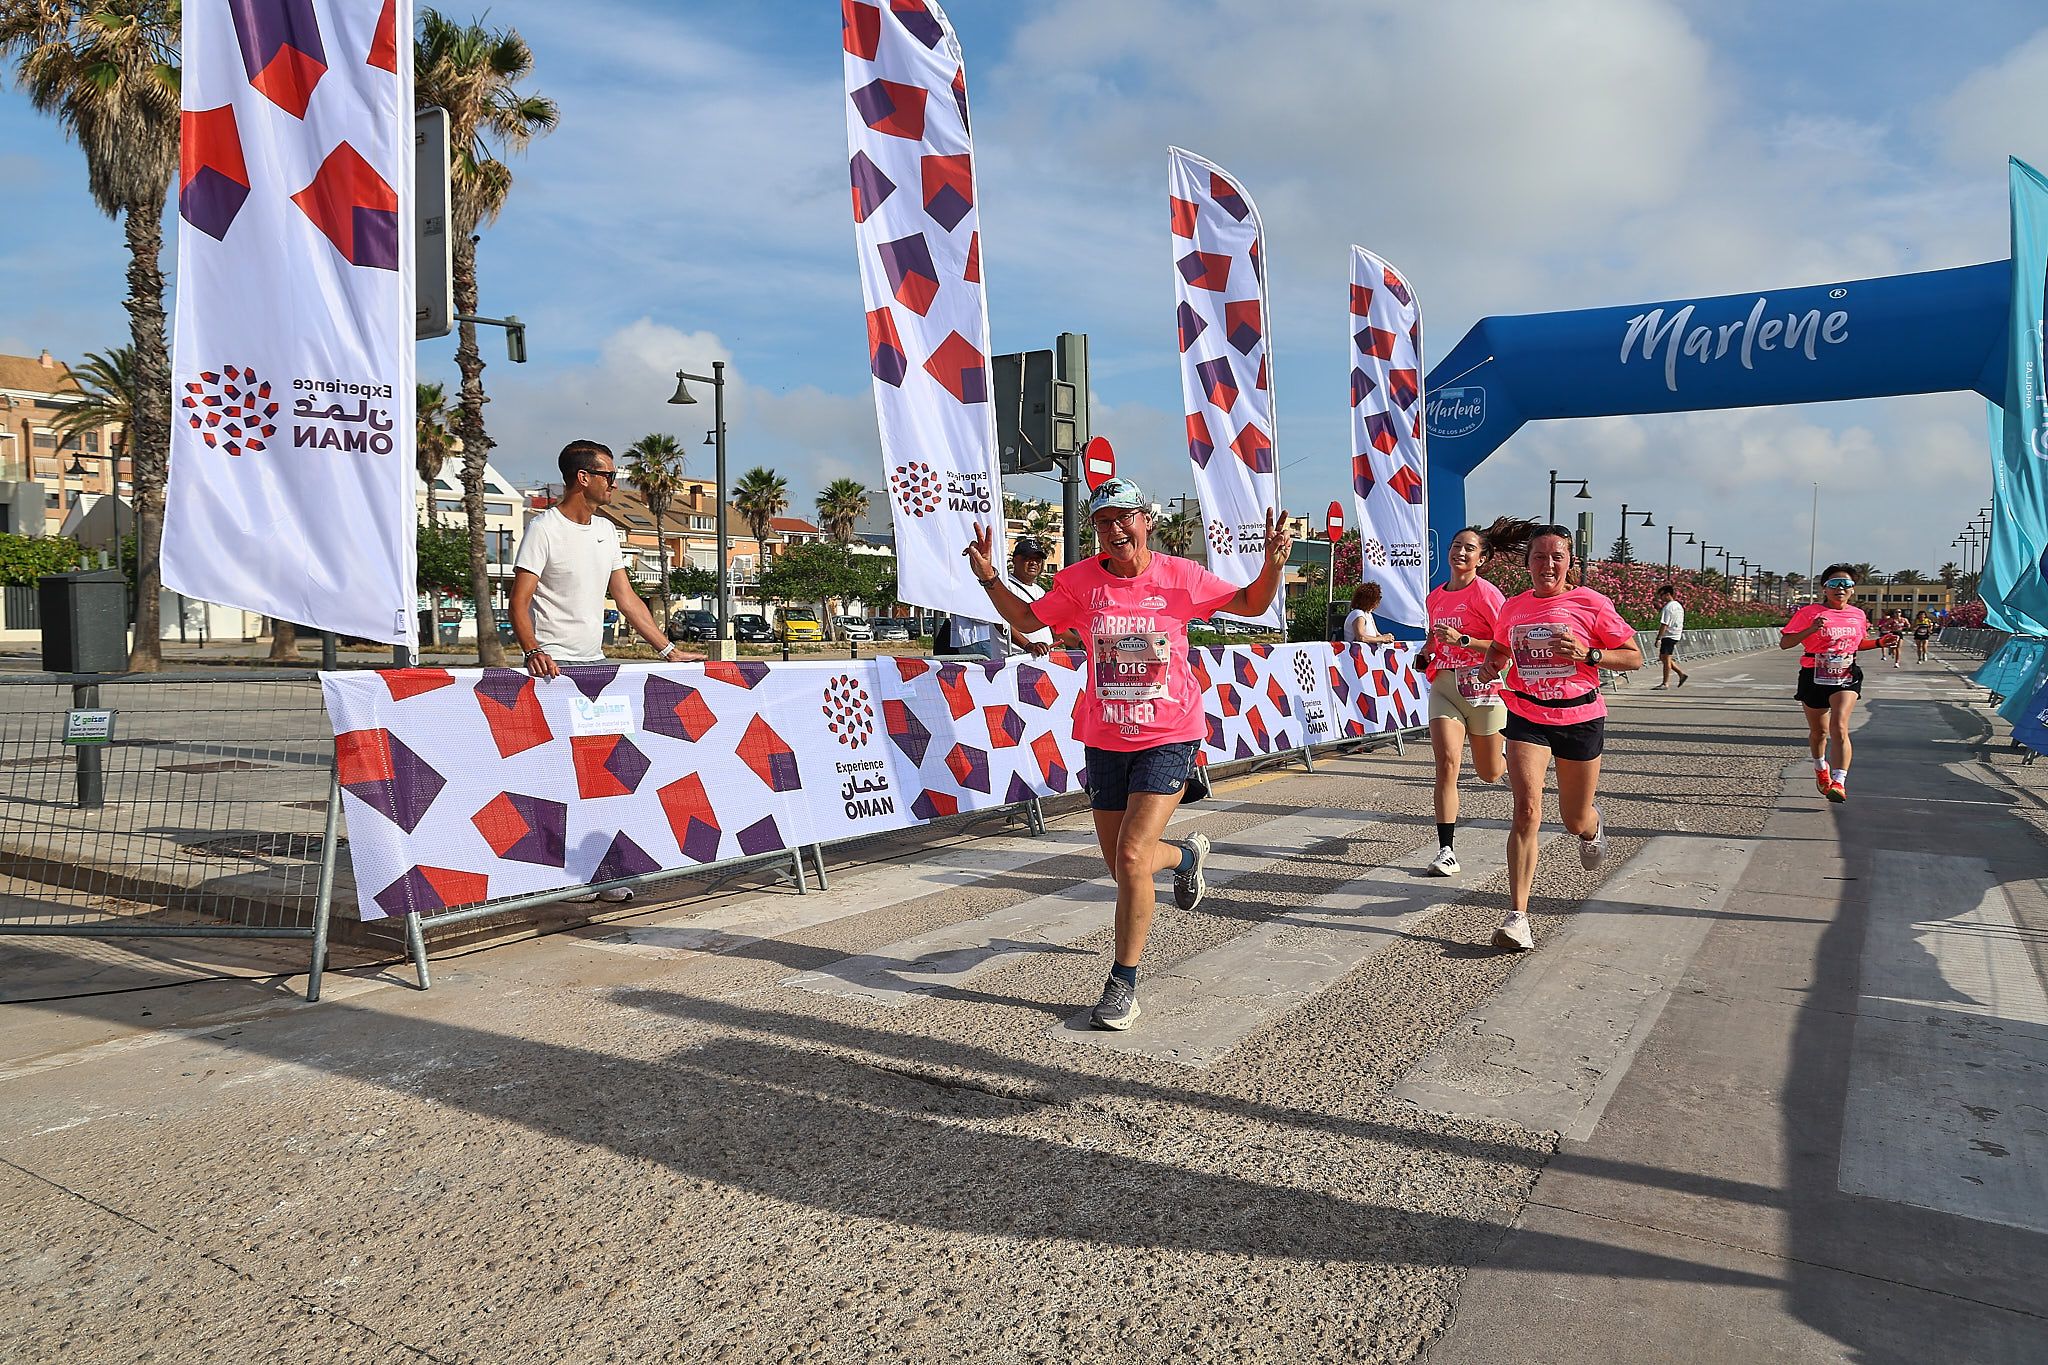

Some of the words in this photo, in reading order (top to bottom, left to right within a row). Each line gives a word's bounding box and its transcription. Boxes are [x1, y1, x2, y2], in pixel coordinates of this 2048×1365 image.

[1620, 297, 1848, 392] Marlene
[1426, 399, 1481, 425] Marlene
[1090, 615, 1156, 634] CARRERA
[1820, 626, 1857, 637] CARRERA
[1530, 648, 1554, 658] 016
[1118, 663, 1147, 674] 016
[1473, 682, 1491, 691] 016
[1102, 702, 1155, 724] MUJER
[1119, 725, 1140, 735] 2026
[1307, 721, 1329, 735] OMAN
[836, 759, 884, 775] Experience
[845, 796, 895, 820] OMAN
